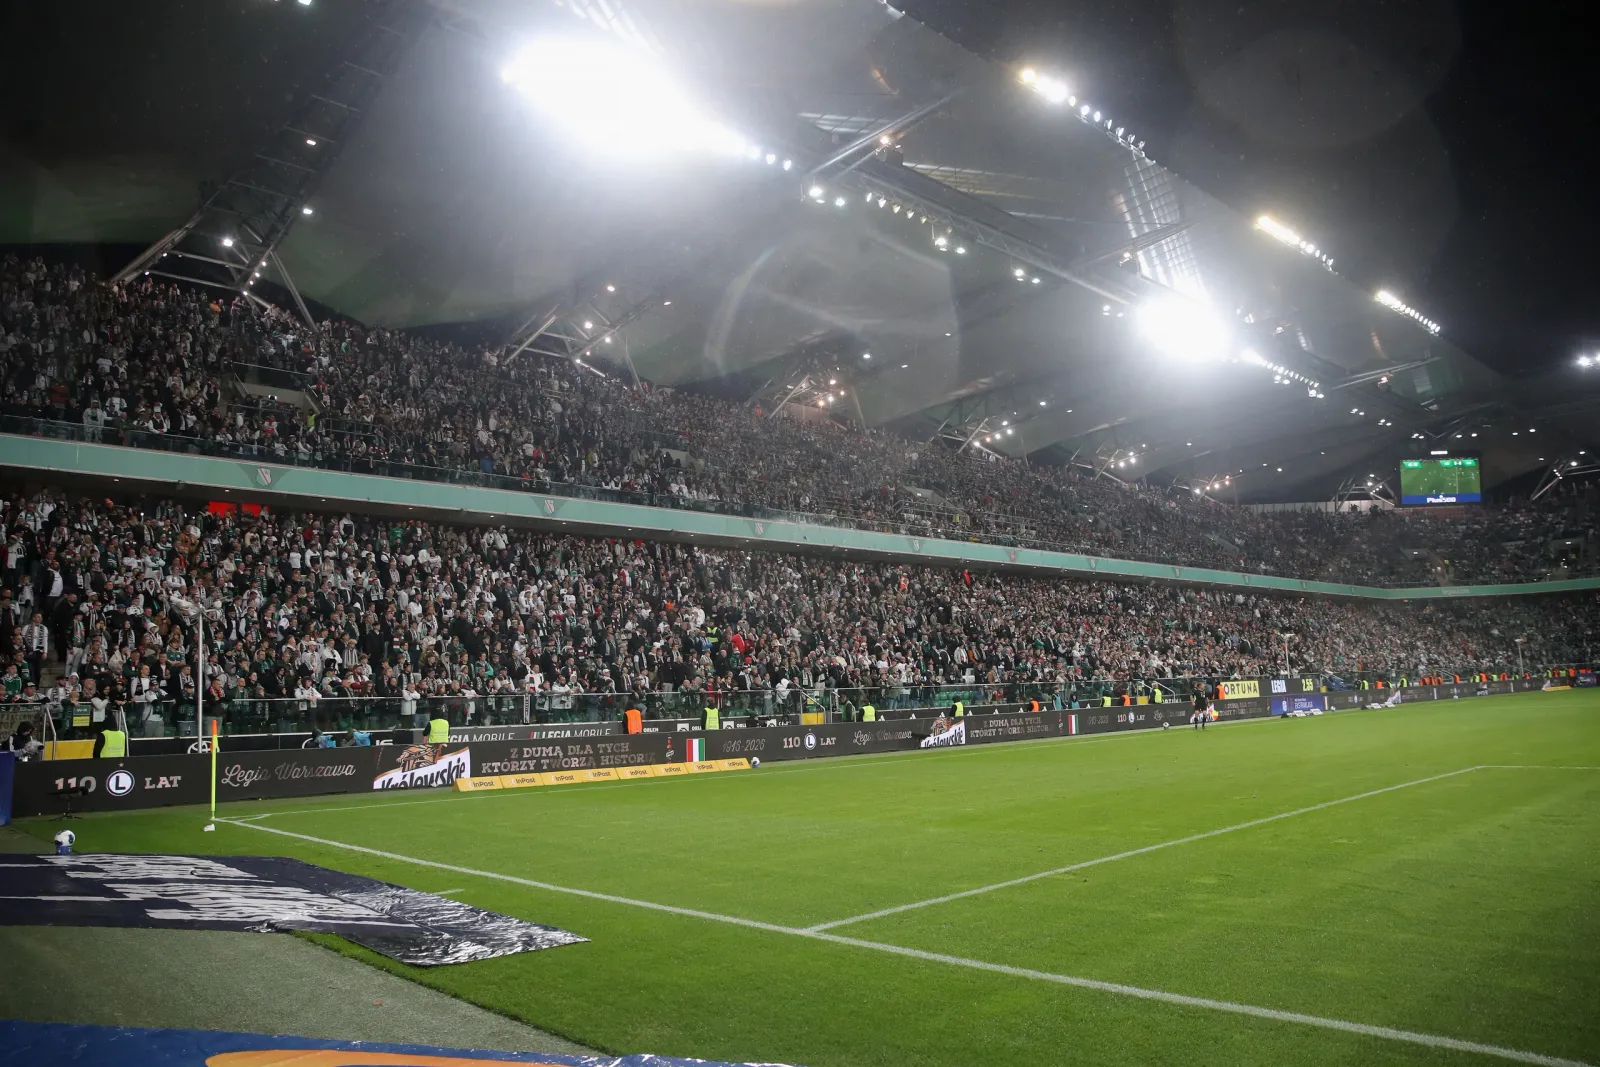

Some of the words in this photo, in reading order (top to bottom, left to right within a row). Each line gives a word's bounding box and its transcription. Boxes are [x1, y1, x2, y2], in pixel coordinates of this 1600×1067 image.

[1222, 681, 1259, 695] ORTUNA
[1271, 680, 1286, 693] LEGIA
[783, 736, 800, 748] 110
[820, 737, 836, 746] LAT
[511, 748, 519, 758] Z
[523, 746, 563, 759] DUMĄ
[568, 744, 593, 756] DLA
[597, 742, 630, 753] TYCH
[481, 757, 536, 773] KTÓRZY
[540, 755, 596, 770] TWORZĄ
[221, 763, 271, 788] Legia
[274, 761, 356, 780] Warszawa
[515, 777, 536, 785] InPost
[55, 776, 97, 793] 110
[144, 775, 182, 790] LAT
